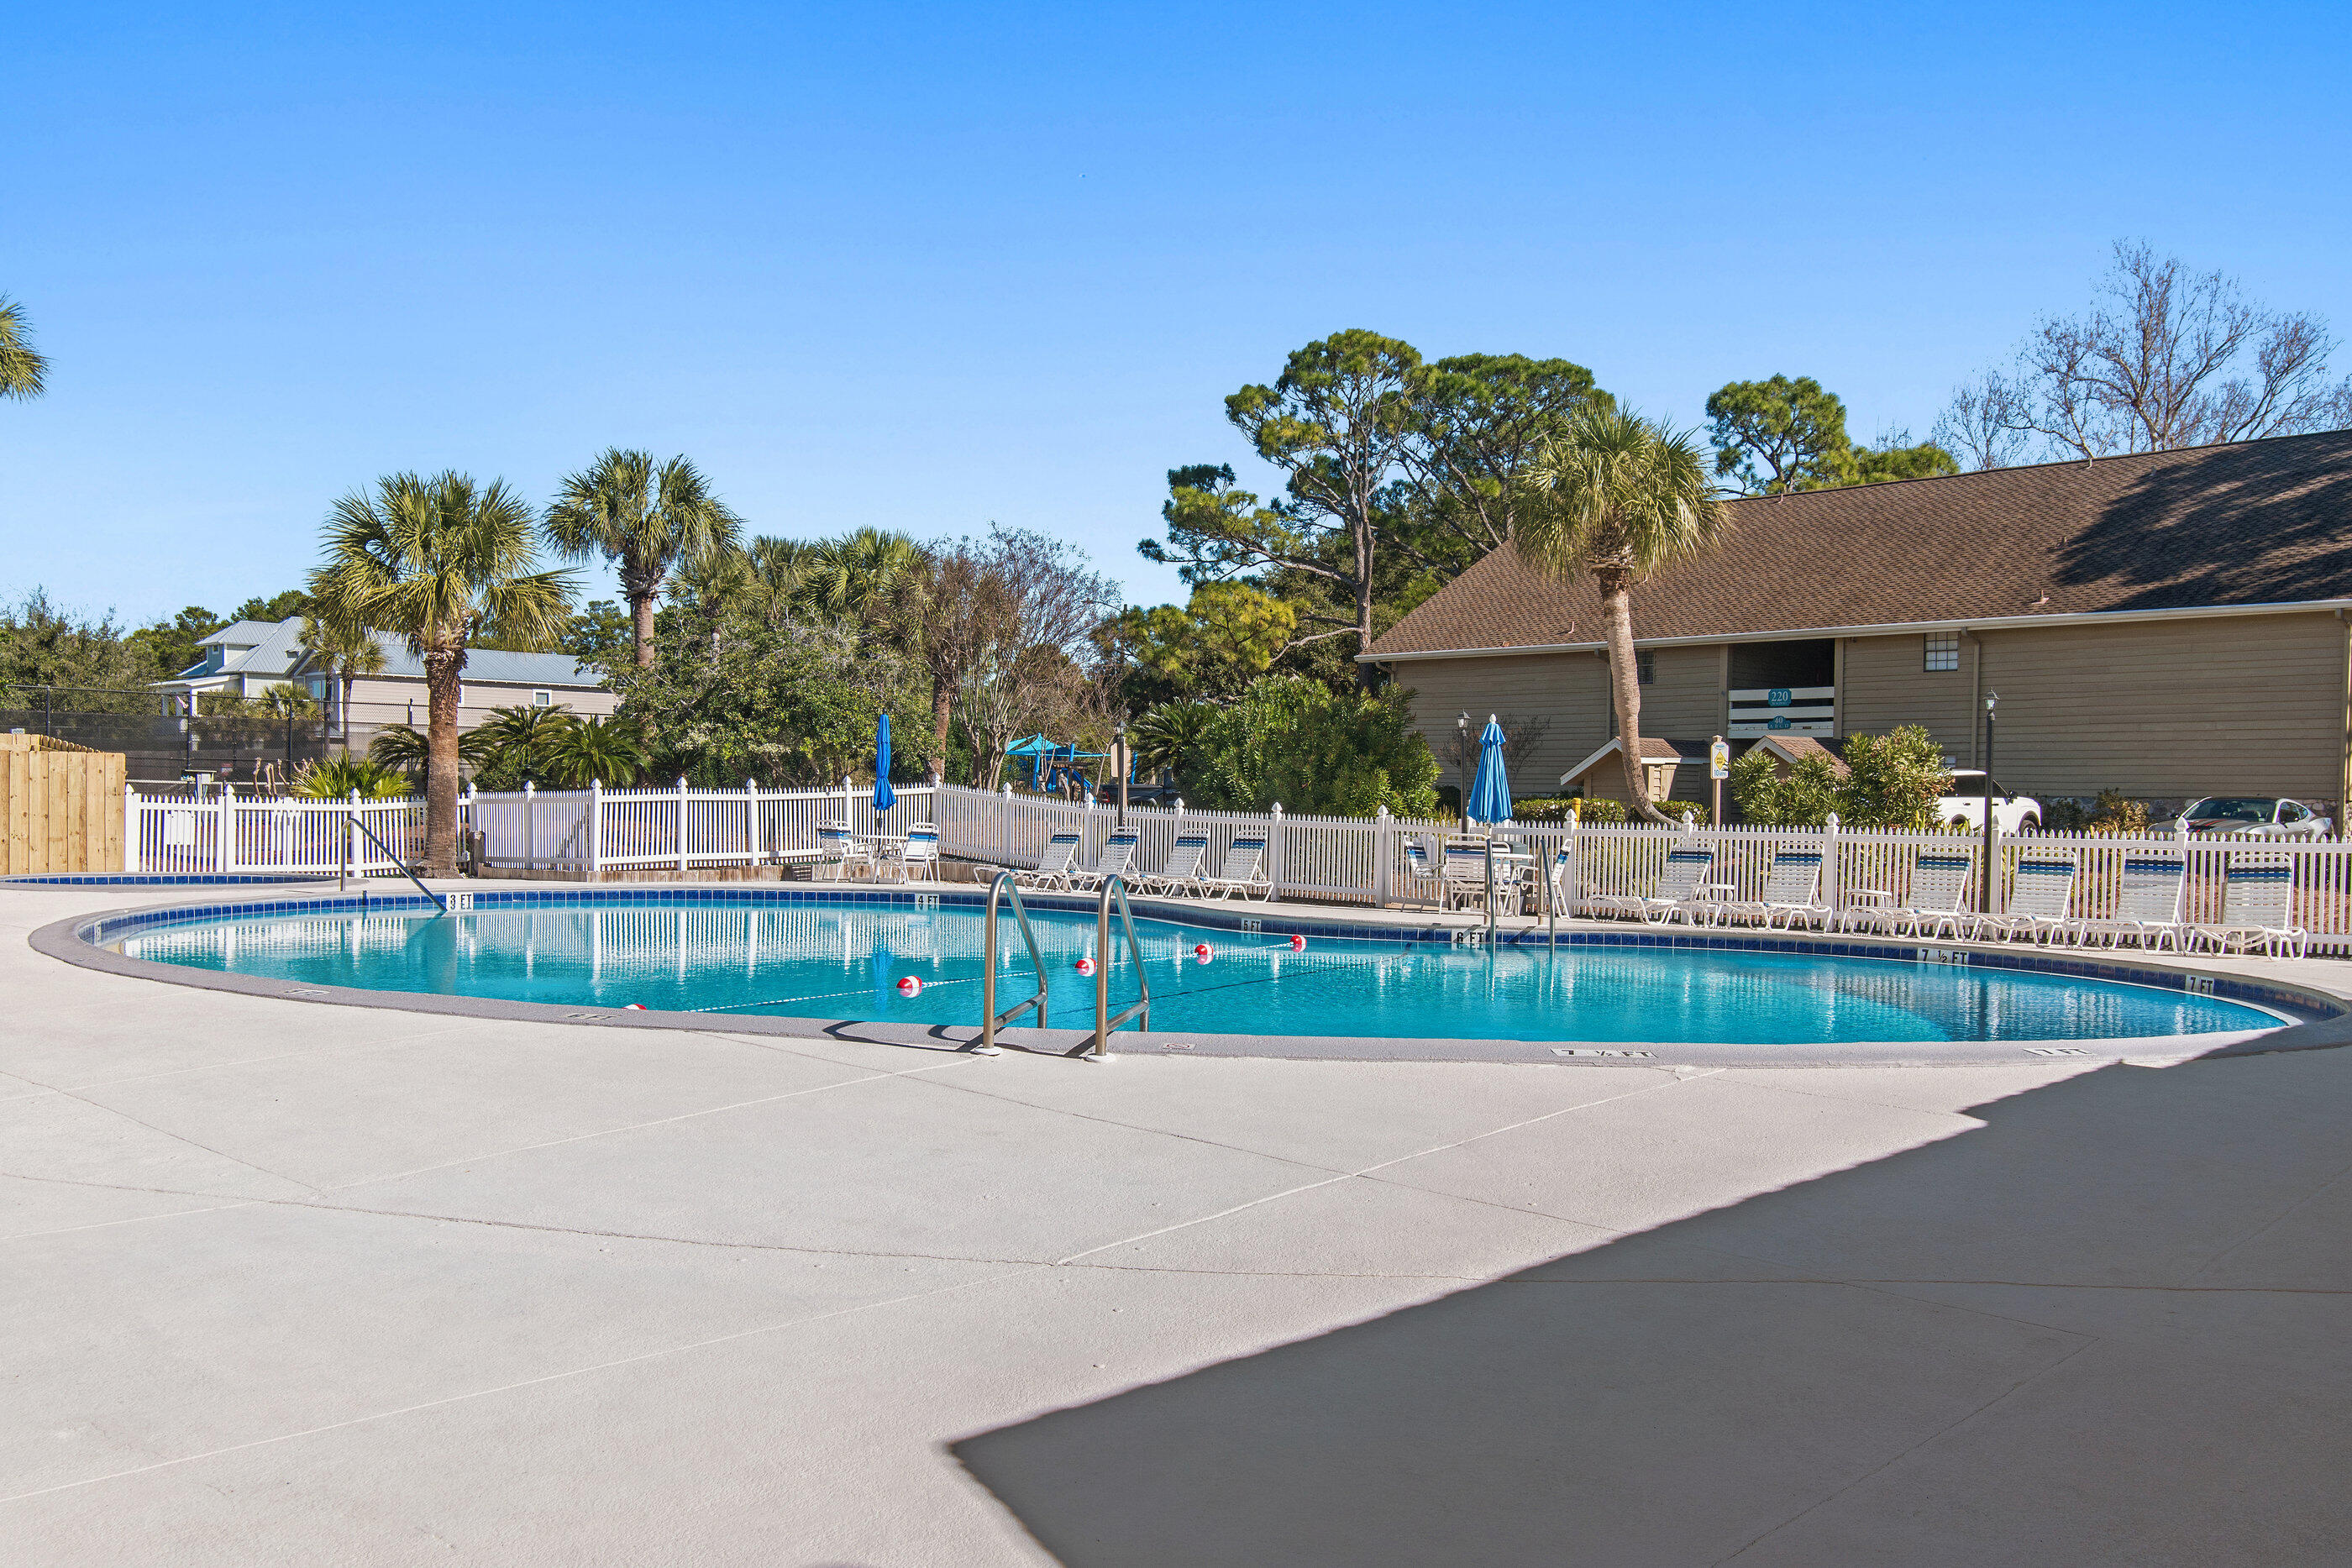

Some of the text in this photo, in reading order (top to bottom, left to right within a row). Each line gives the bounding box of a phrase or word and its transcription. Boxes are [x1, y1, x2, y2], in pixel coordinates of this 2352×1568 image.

[1771, 691, 1788, 702] 220
[918, 895, 938, 905] 4 FT
[1243, 920, 1260, 932] 5 FT
[1457, 931, 1484, 942] 6 FT
[1921, 948, 1929, 962] 7
[1951, 951, 1967, 965] FT
[2190, 976, 2213, 995] 7 FT
